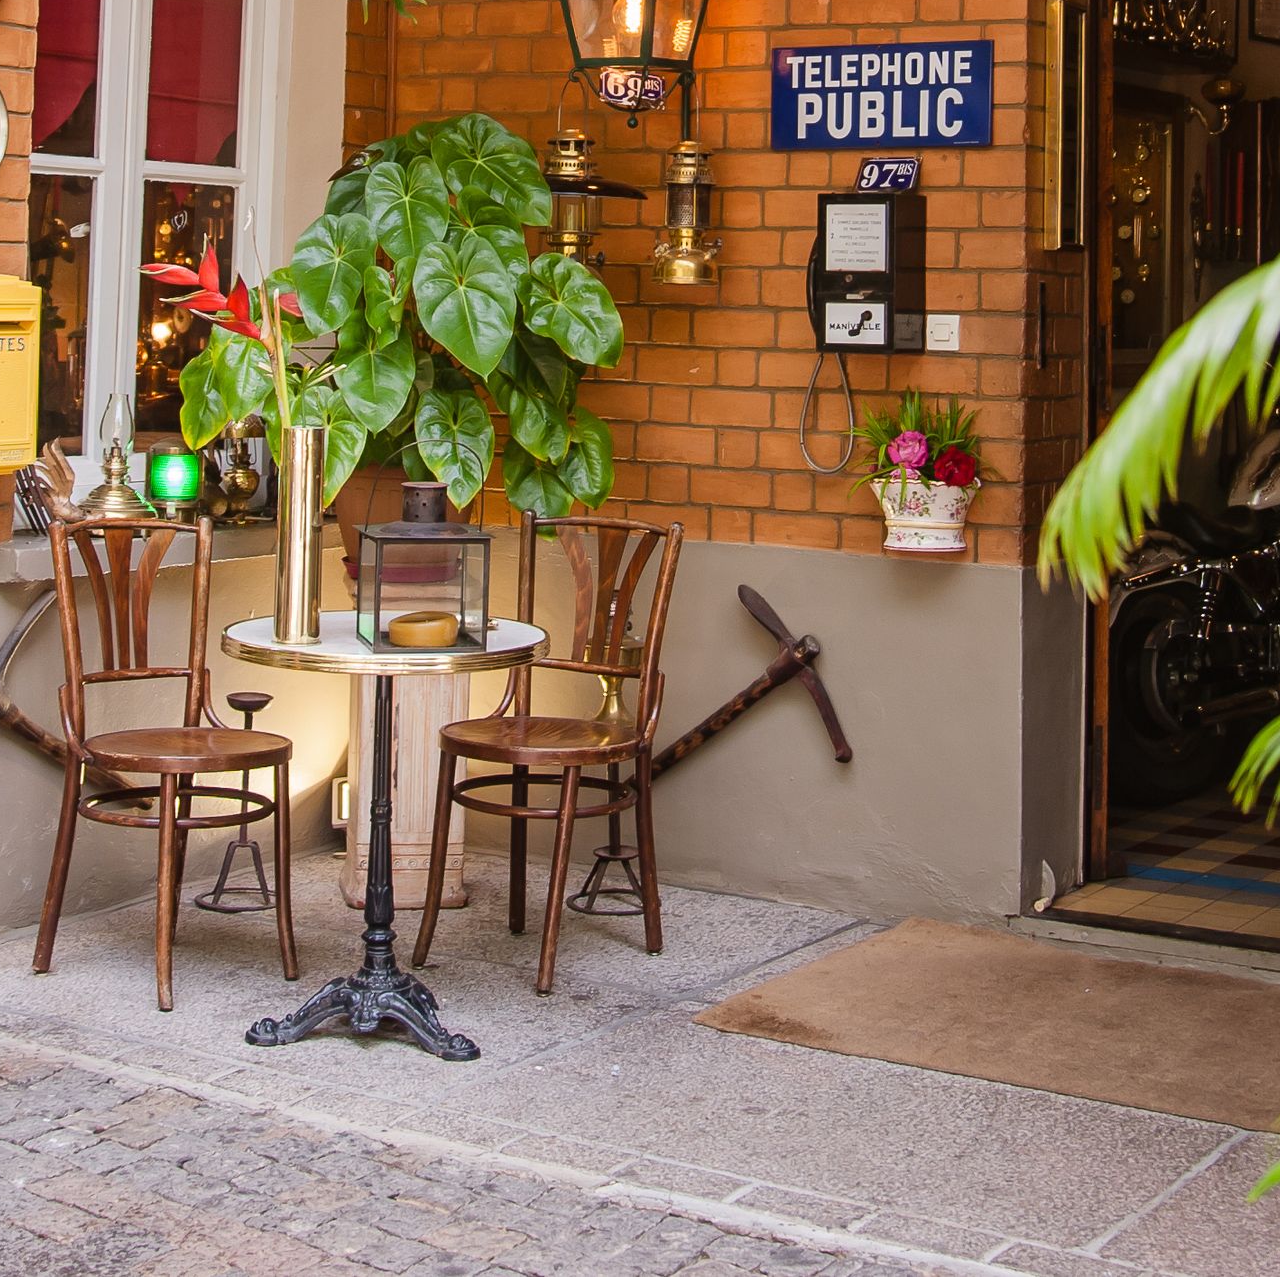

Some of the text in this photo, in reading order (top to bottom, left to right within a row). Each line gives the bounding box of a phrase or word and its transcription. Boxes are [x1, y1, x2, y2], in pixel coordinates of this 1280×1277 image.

[787, 50, 972, 88] TELEPHONE
[607, 73, 642, 97] 69
[797, 88, 963, 139] PUBLIC
[860, 163, 913, 188] 97 BIS
